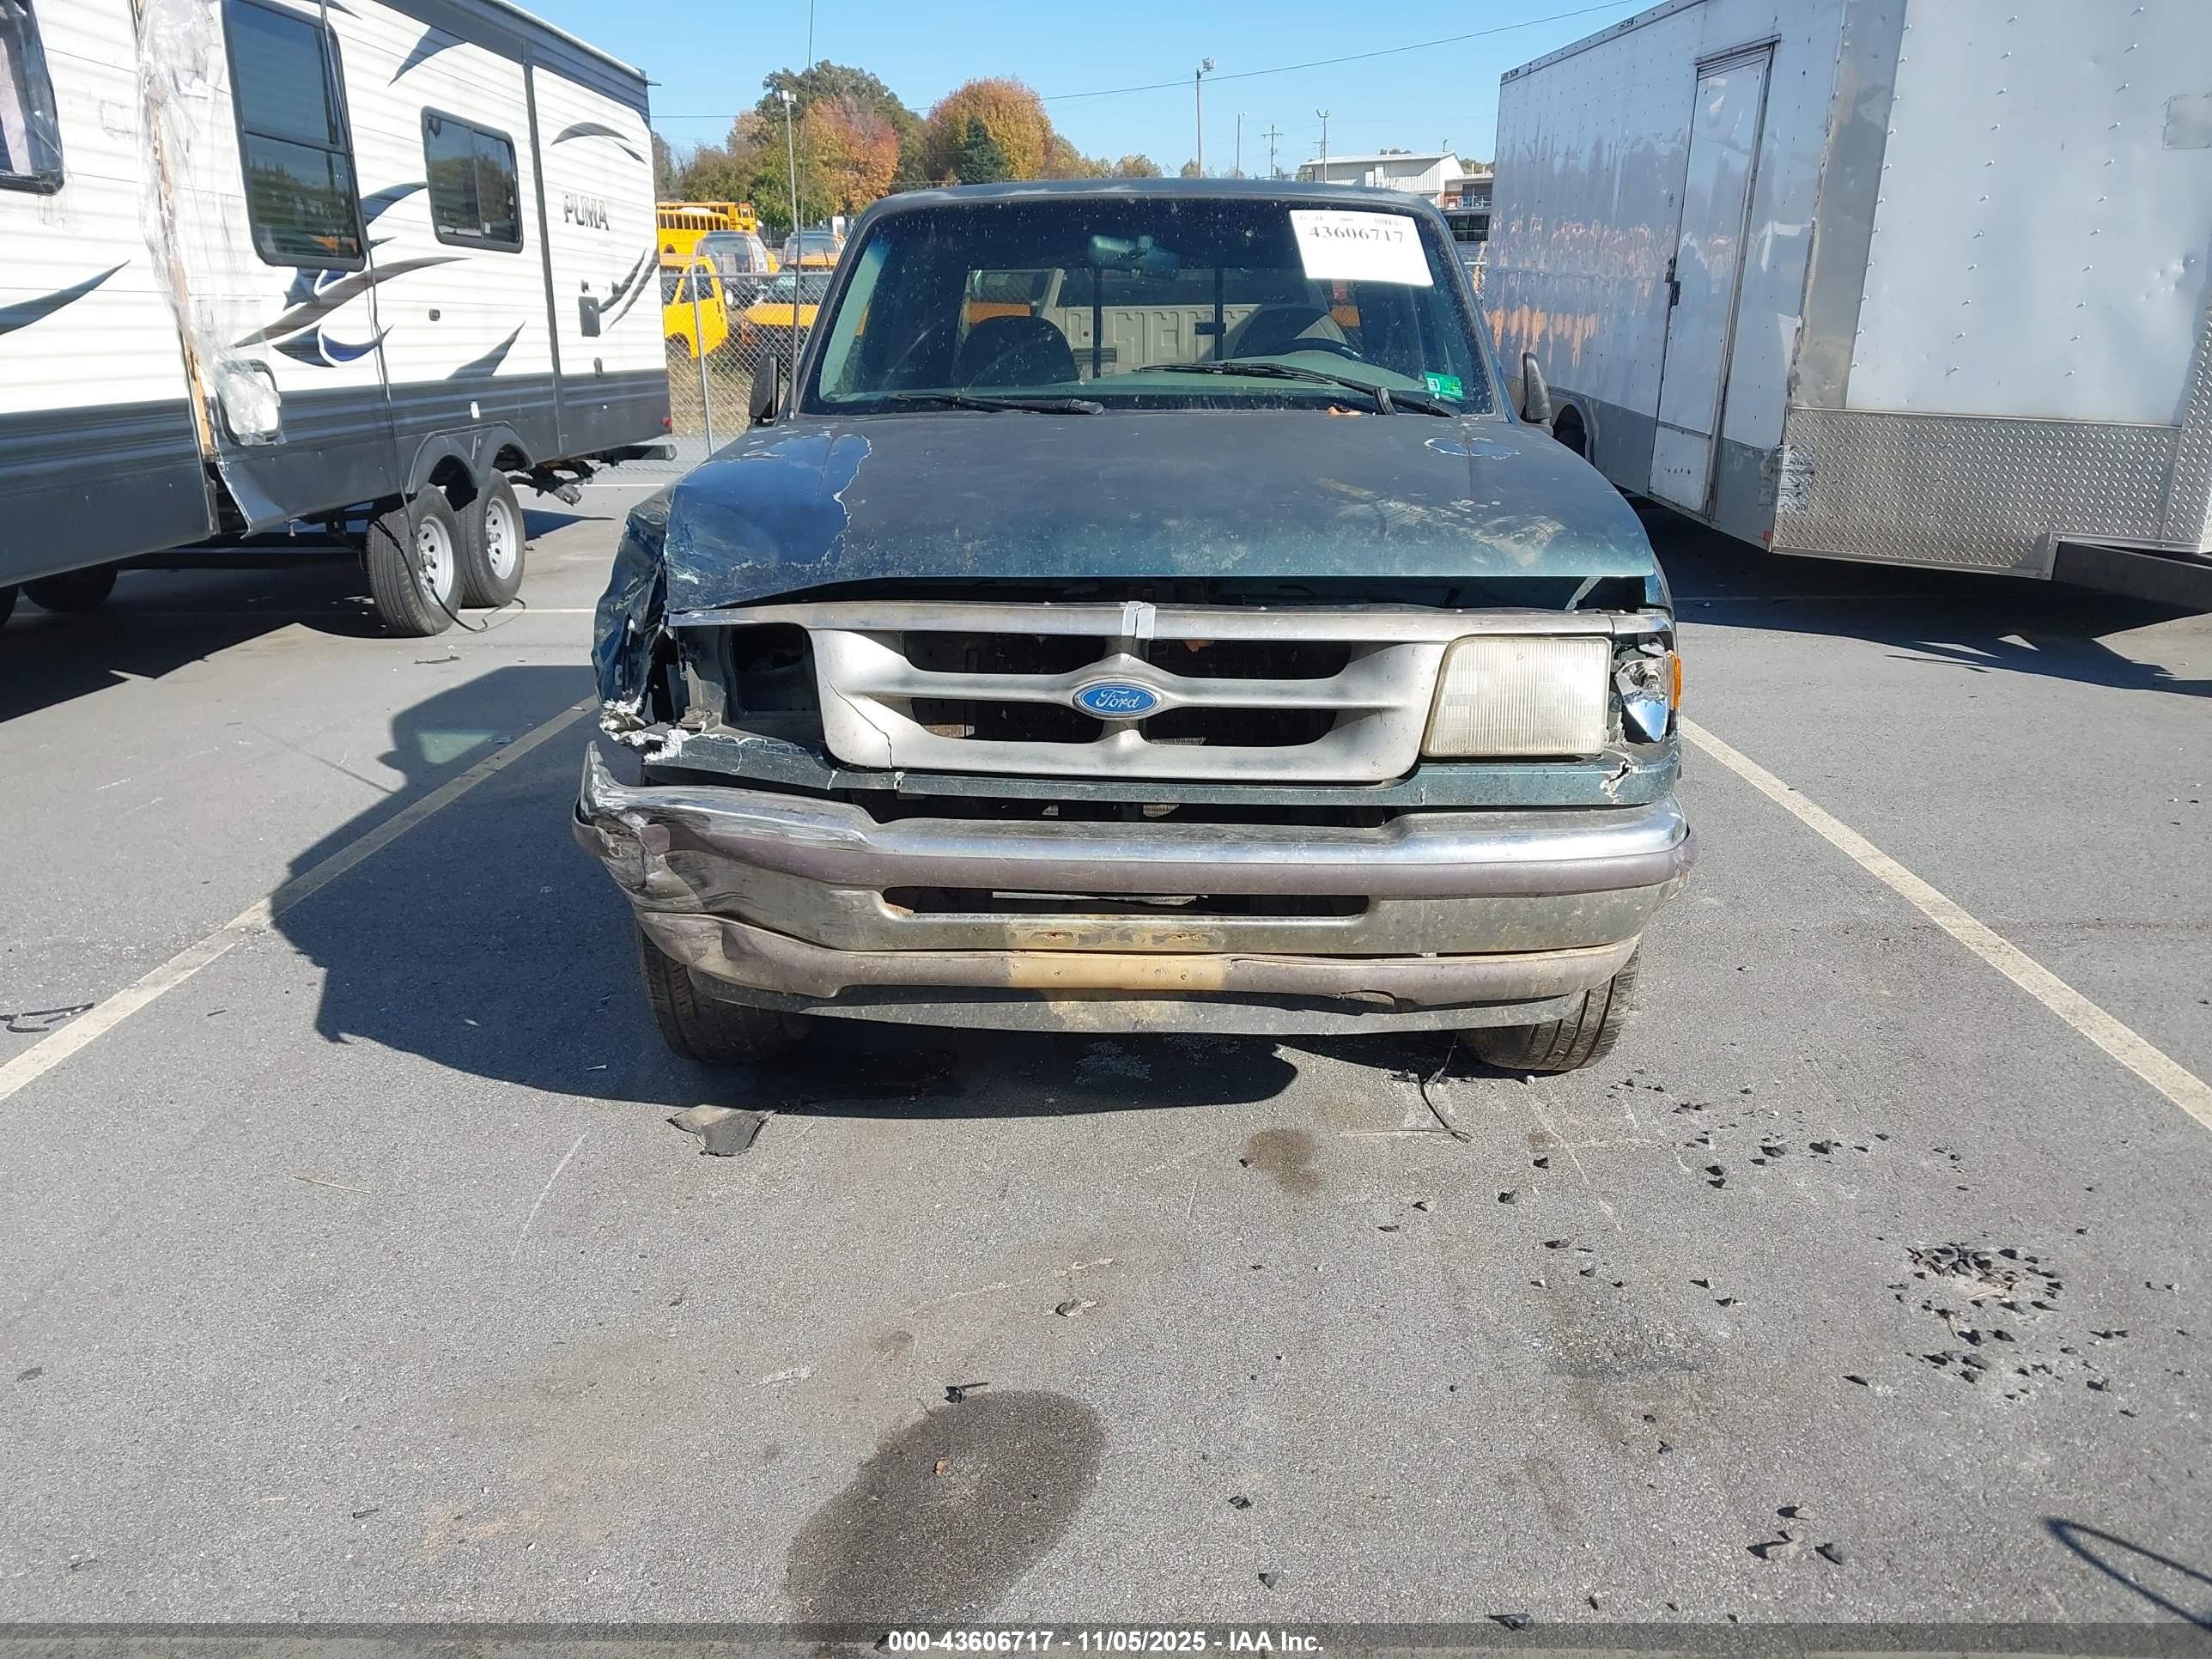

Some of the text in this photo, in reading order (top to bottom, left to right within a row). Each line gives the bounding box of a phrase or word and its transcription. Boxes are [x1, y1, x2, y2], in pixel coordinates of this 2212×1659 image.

[562, 191, 610, 231] PUMA
[1310, 227, 1403, 242] 43606717
[1096, 689, 1140, 708] Ford
